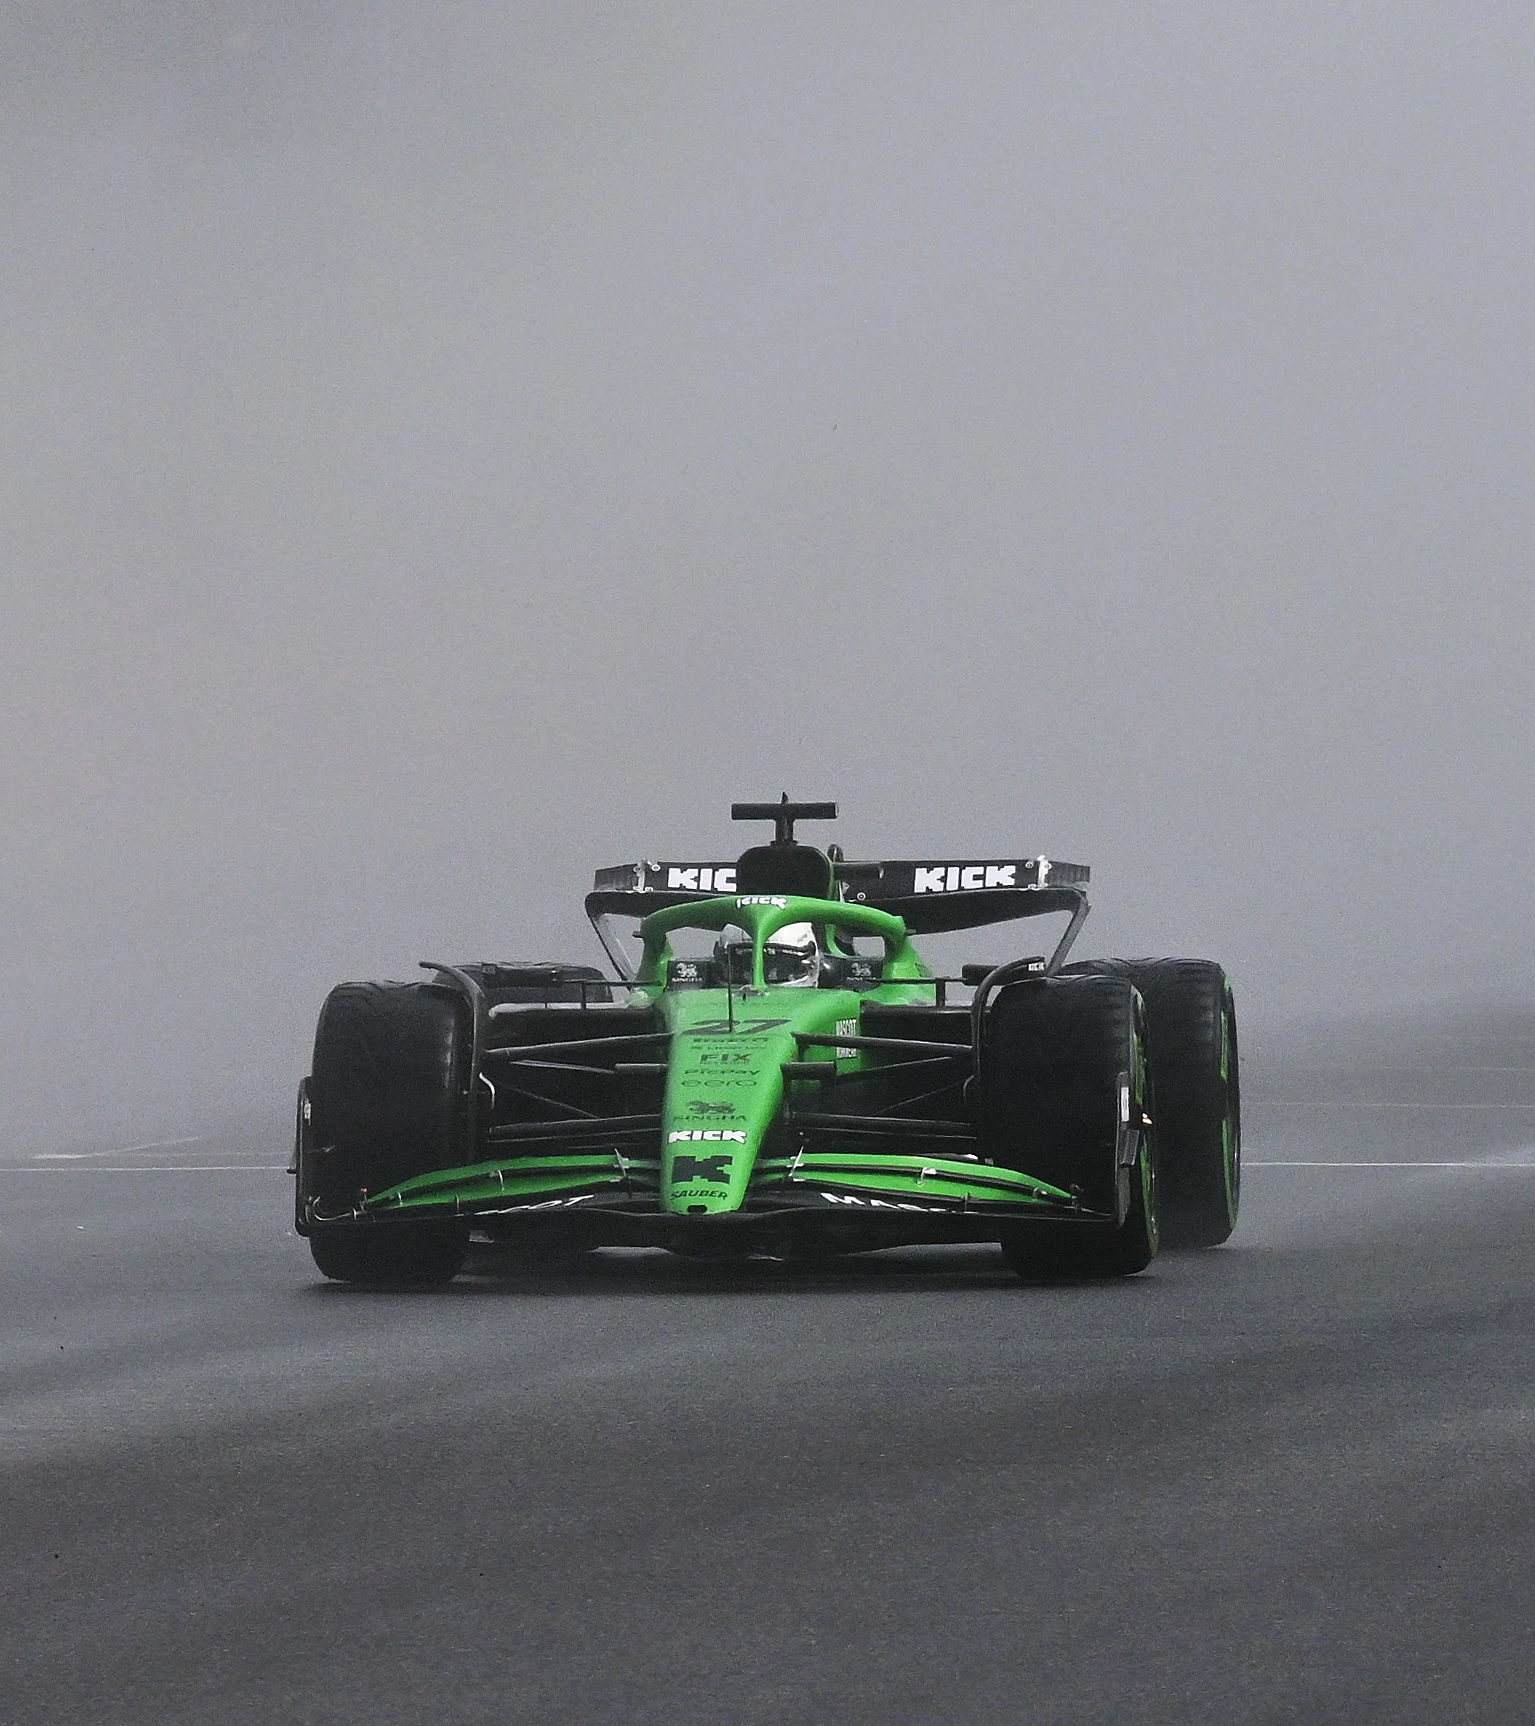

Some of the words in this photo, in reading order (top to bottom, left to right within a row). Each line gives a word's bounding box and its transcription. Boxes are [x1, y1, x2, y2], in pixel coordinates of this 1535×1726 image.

[667, 867, 737, 892] KIC
[913, 865, 1016, 893] KICK
[736, 897, 787, 909] KICK
[681, 1018, 792, 1035] 27
[700, 1053, 751, 1062] FIX
[668, 1130, 747, 1144] KICK
[671, 1155, 733, 1184] K
[670, 1190, 728, 1200] SAUBER
